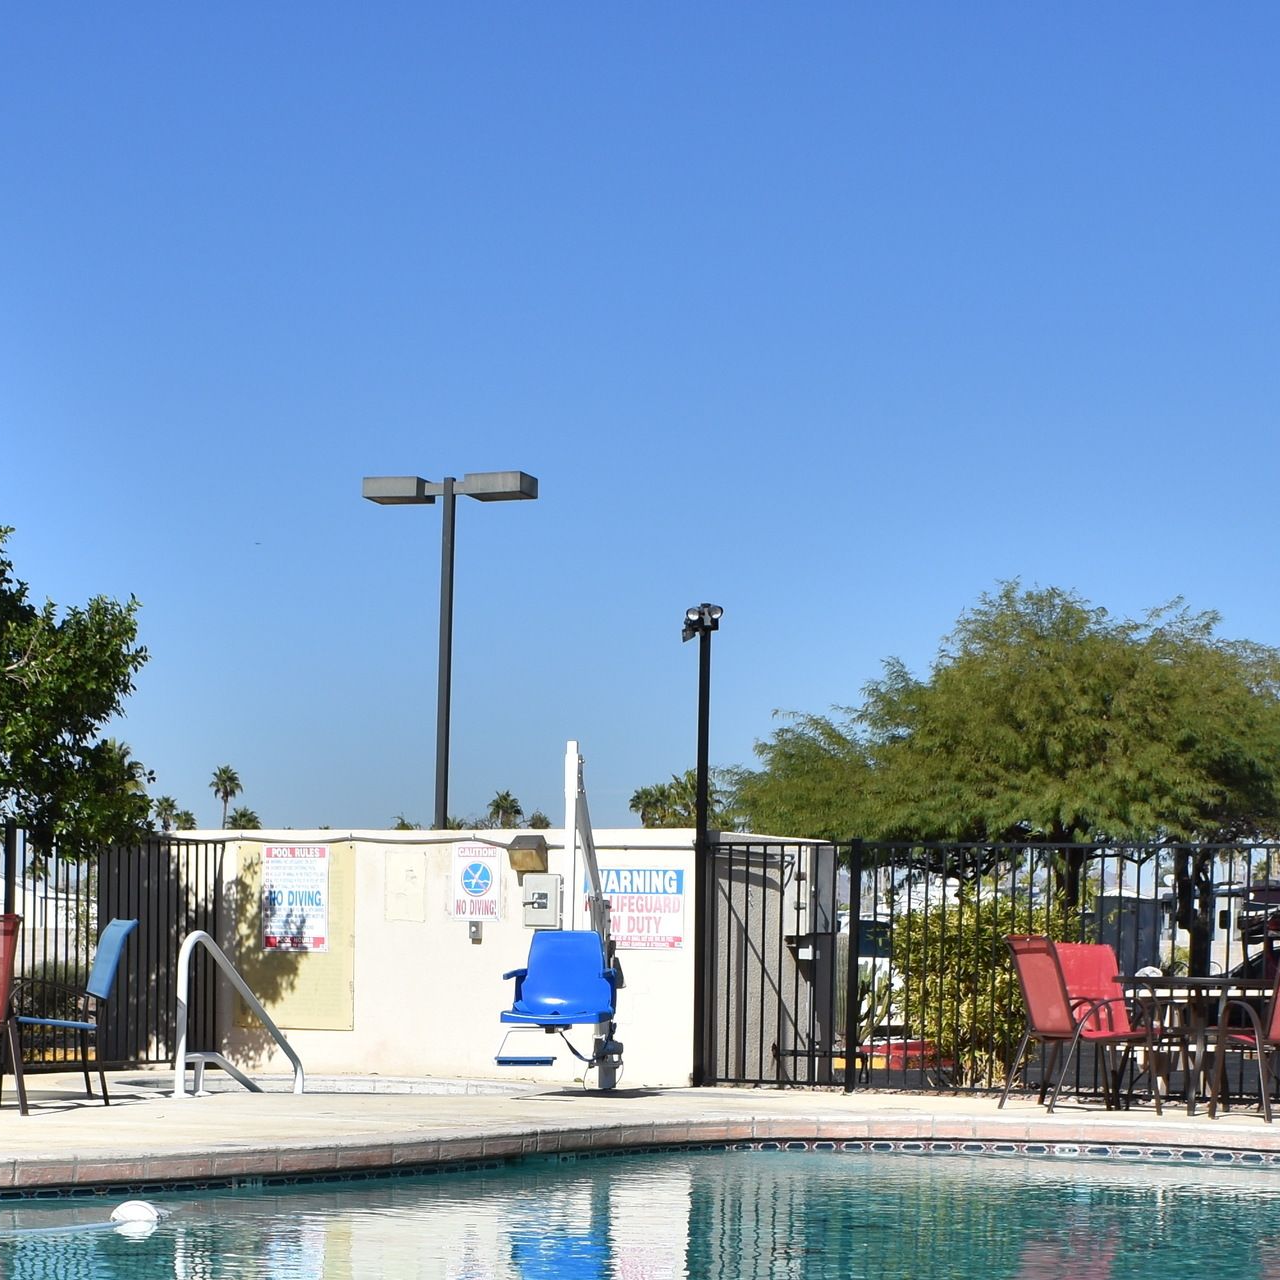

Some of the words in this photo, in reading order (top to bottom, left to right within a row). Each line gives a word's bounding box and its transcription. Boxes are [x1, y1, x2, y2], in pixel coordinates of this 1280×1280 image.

[272, 848, 292, 857] POOL
[295, 848, 320, 857] RULES
[459, 848, 496, 857] CAUTION!
[269, 890, 283, 906] NO
[608, 895, 681, 913] LIFEGUARD
[456, 900, 466, 915] NO
[470, 900, 496, 915] DIVING!
[626, 916, 662, 933] DUTY
